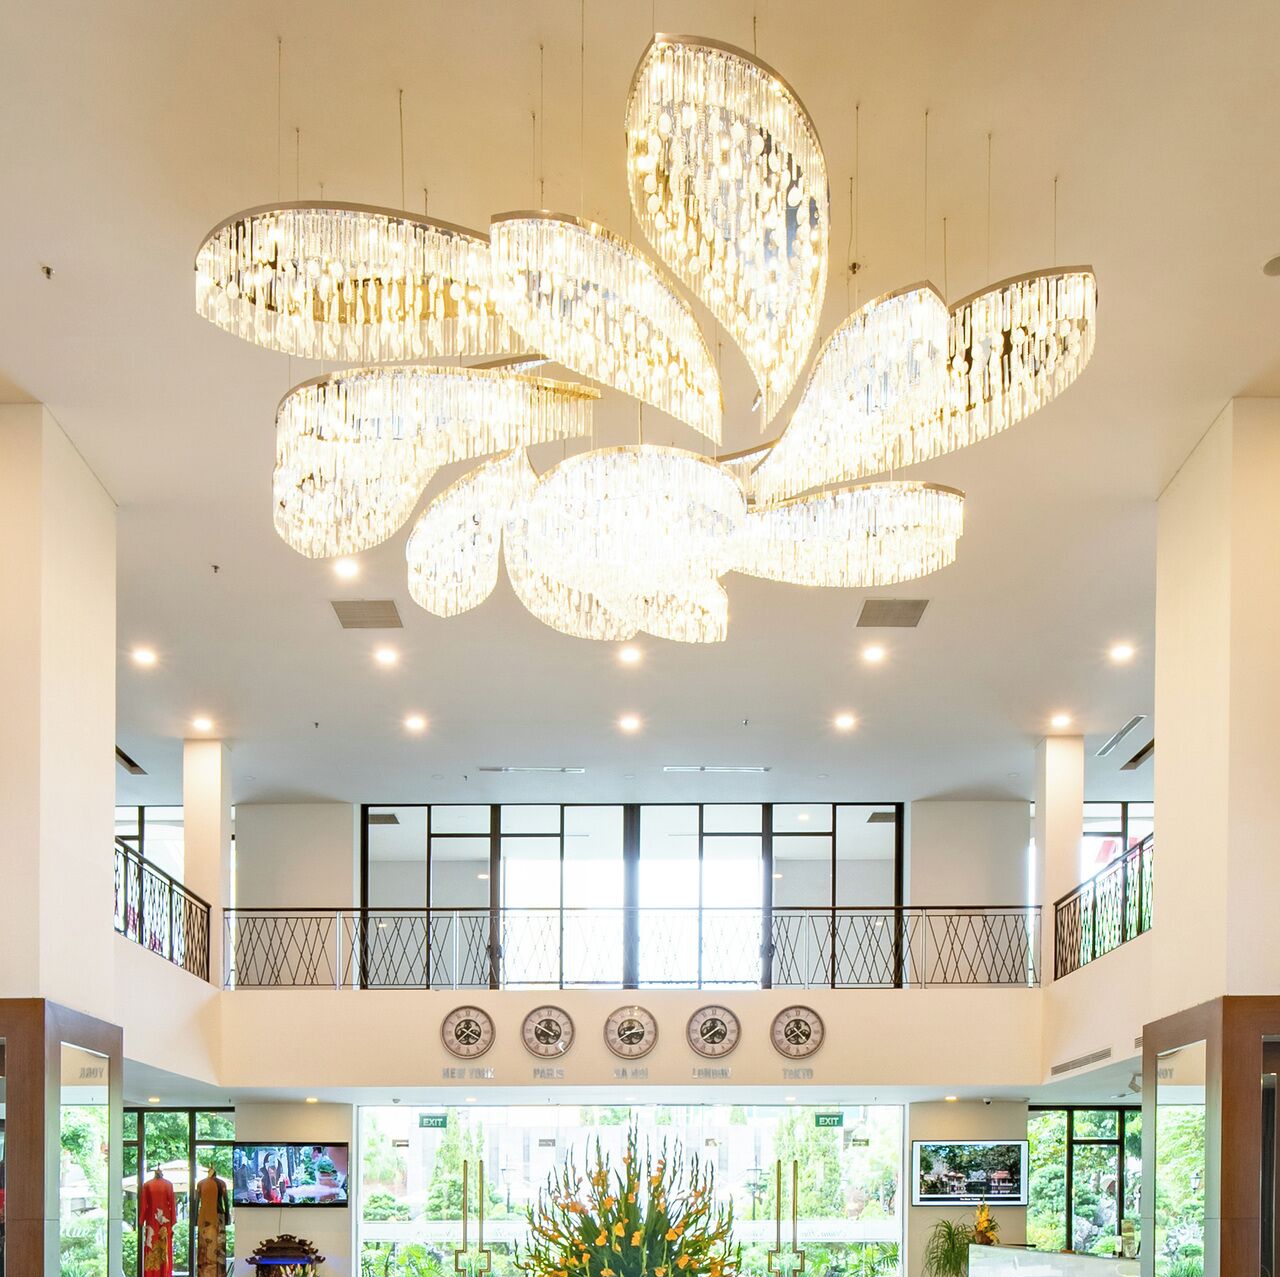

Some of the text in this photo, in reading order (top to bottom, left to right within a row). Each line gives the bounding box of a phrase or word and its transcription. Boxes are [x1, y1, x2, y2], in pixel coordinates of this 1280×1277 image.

[533, 1067, 564, 1079] PARIS
[423, 1118, 443, 1126] EXIT
[819, 1117, 839, 1125] EXIT
